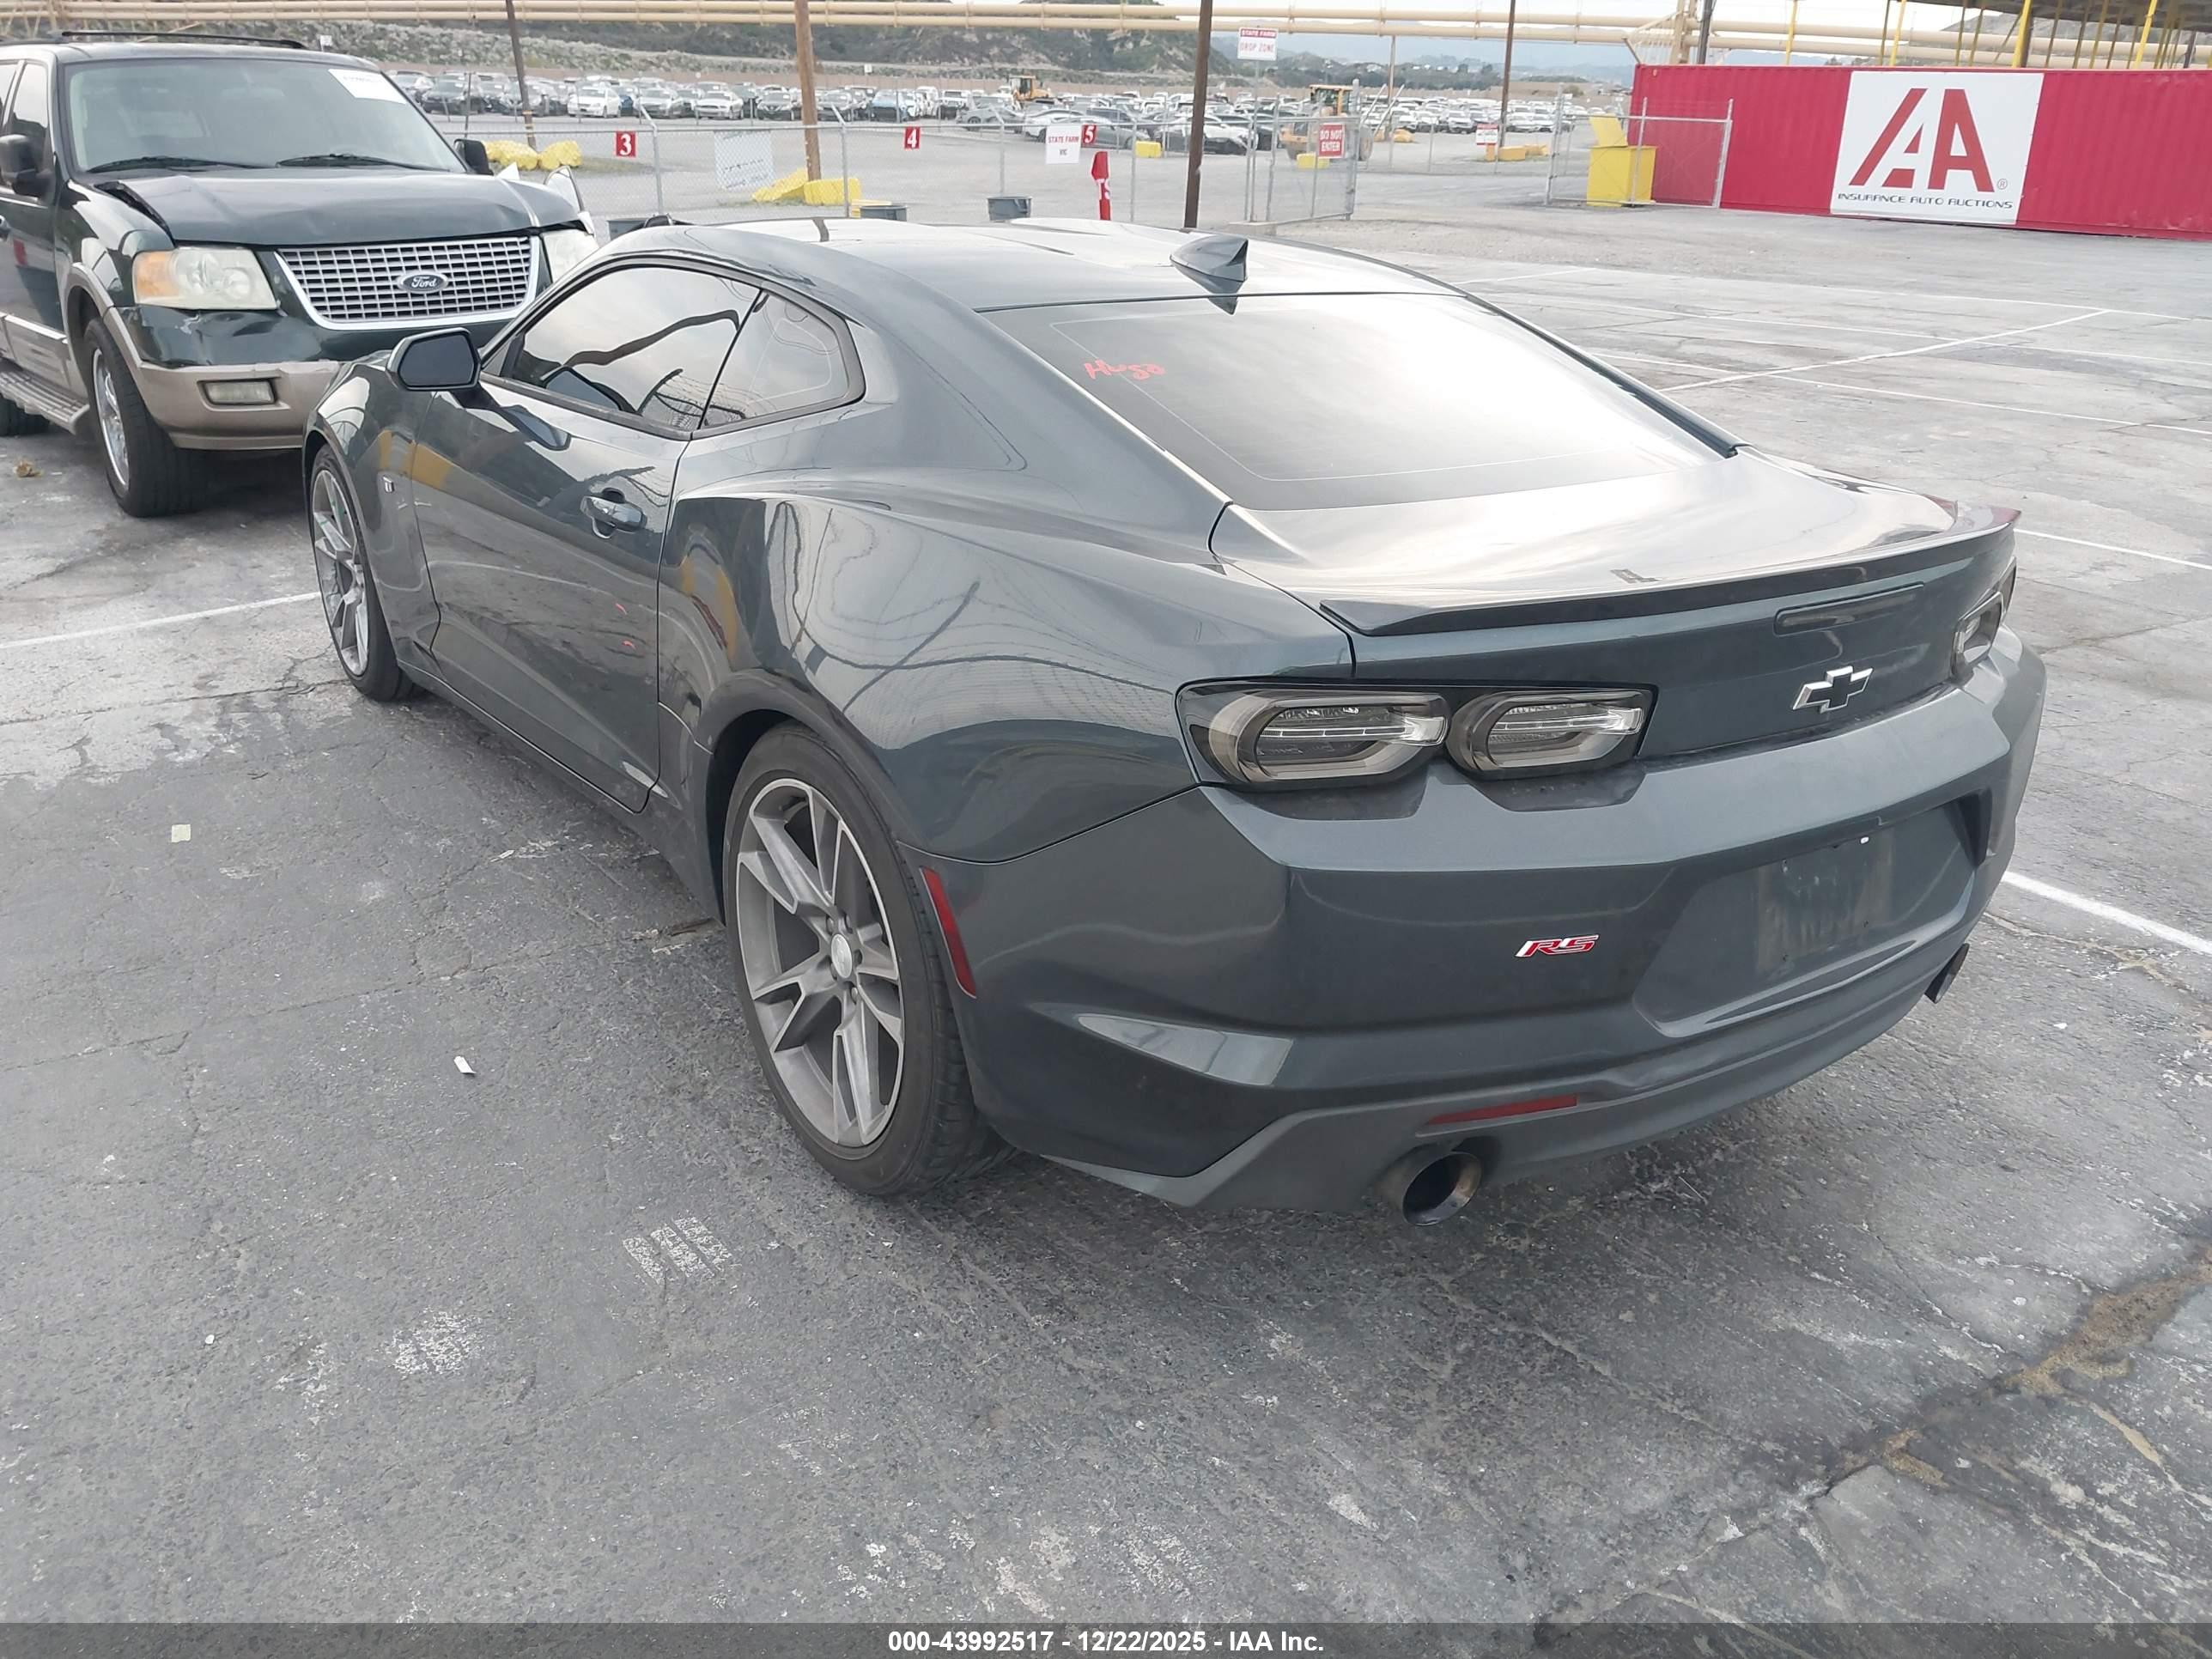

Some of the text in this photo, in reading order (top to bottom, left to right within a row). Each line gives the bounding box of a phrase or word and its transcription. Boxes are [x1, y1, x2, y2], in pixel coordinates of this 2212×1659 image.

[907, 128, 917, 148] 4
[1085, 125, 1095, 143] 5
[1320, 130, 1342, 140] DO NOT
[619, 132, 633, 156] 3
[1321, 141, 1340, 152] ENTER
[1838, 192, 2014, 209] INSURANCE AUTO AUCTIONS
[411, 276, 437, 288] Ford
[1515, 934, 1599, 957] RS
